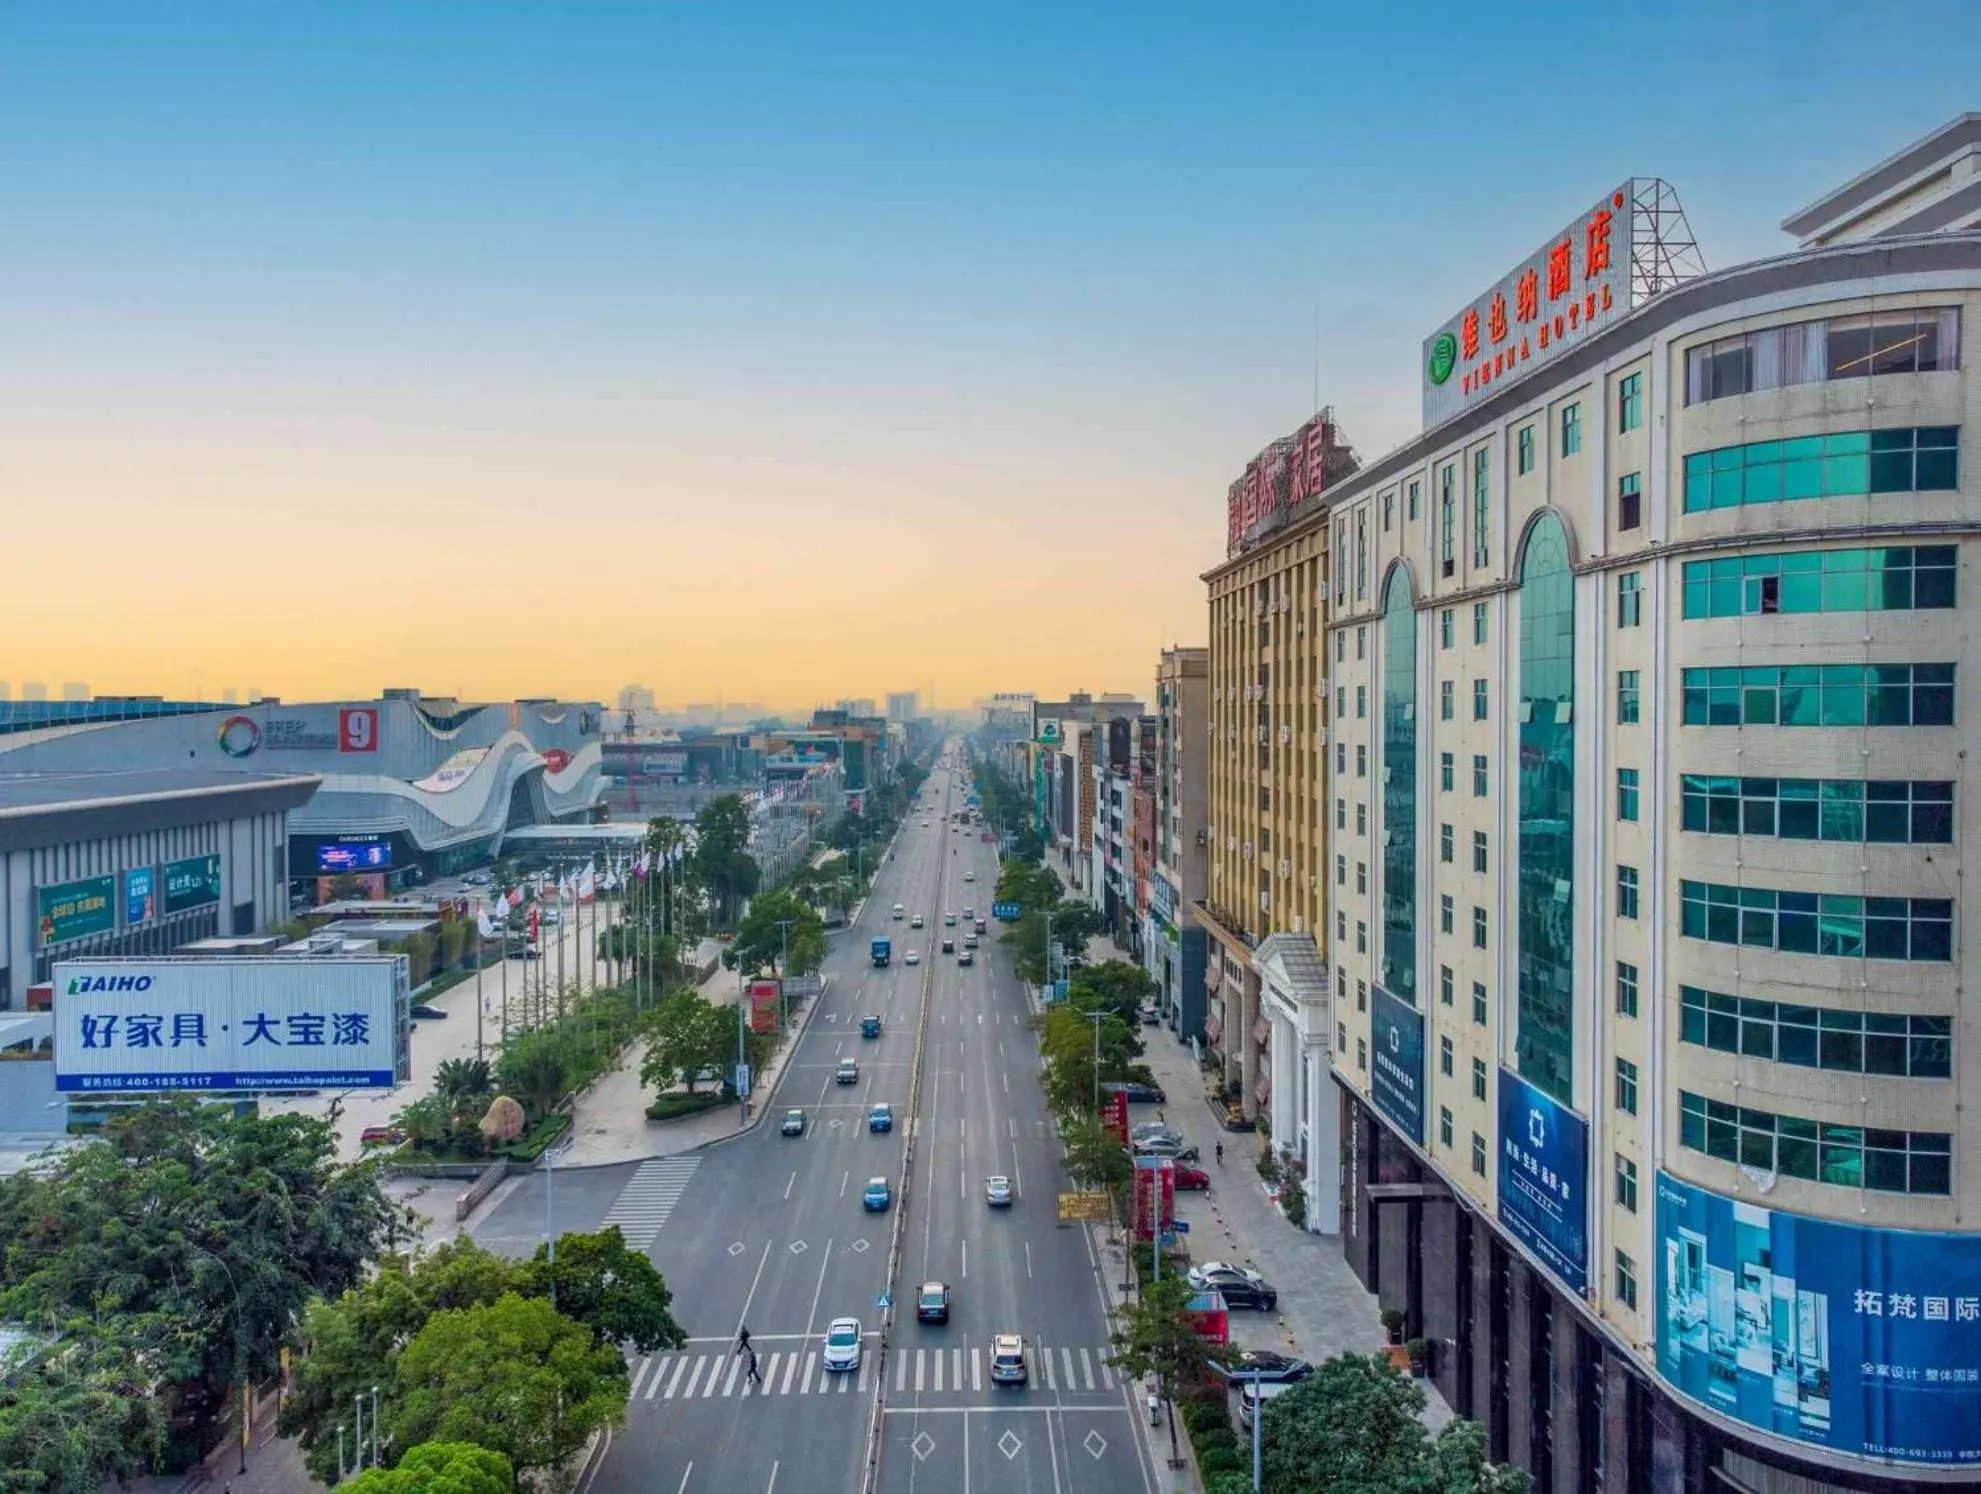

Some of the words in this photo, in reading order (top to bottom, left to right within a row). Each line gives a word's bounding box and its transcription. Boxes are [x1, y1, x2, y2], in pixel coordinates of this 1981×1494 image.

[1461, 210, 1612, 360] 维也纳酒店
[1461, 337, 1529, 395] VIENNA
[1538, 284, 1612, 349] HOTEL
[347, 711, 370, 748] 9
[67, 976, 151, 995] TAIHO
[80, 1012, 370, 1048] 好家具·大宝漆
[1854, 1289, 1980, 1321] 拓梵国际
